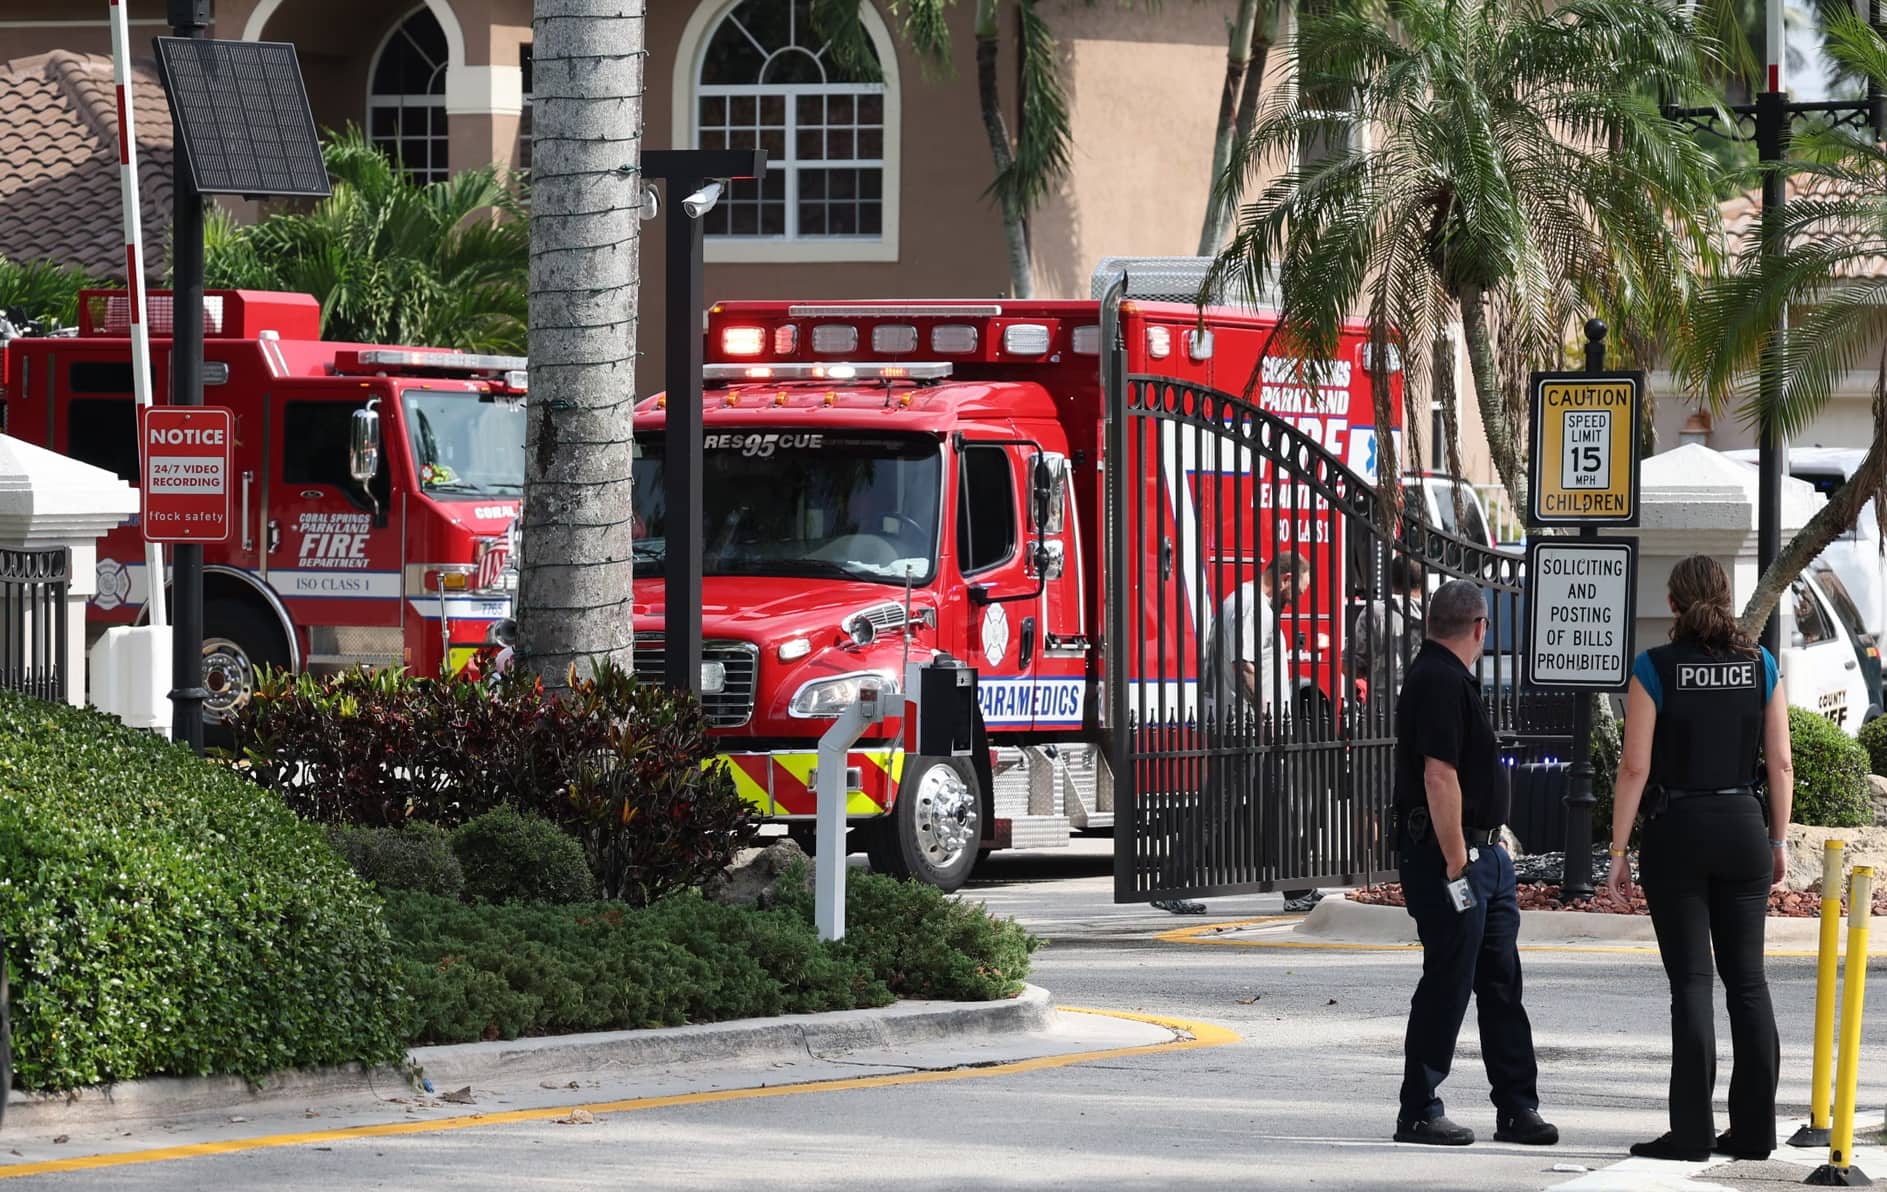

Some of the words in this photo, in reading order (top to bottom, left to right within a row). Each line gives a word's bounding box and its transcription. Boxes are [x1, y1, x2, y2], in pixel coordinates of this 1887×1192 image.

[1548, 389, 1627, 406] CAUTION
[1568, 415, 1606, 428] SPEED
[150, 428, 224, 445] NOTICE
[1571, 429, 1602, 443] LIMIT
[1571, 446, 1601, 473] 15
[154, 464, 180, 474] 24/7
[184, 464, 219, 475] VIDEO
[152, 477, 220, 487] RECORDING
[1575, 475, 1596, 486] MPH
[1545, 493, 1624, 512] CHILDREN
[185, 511, 224, 524] safety
[299, 513, 328, 523] CORAL
[330, 513, 371, 523] SPRINGS
[474, 505, 515, 519] CORAL
[299, 522, 371, 534] PARKLAND
[298, 534, 371, 558] FIRE
[298, 558, 370, 568] DEPARTMENT
[1543, 559, 1623, 577] SOLICITING
[296, 577, 317, 591] ISO
[321, 577, 360, 591] CLASS
[1567, 583, 1597, 600] AND
[1550, 606, 1612, 624] POSTING
[1546, 629, 1565, 646] OF
[1573, 630, 1613, 647] BILLS
[1537, 652, 1620, 671] PROHIBITED
[1681, 665, 1753, 687] POLICE
[1818, 689, 1847, 709] COUNTY
